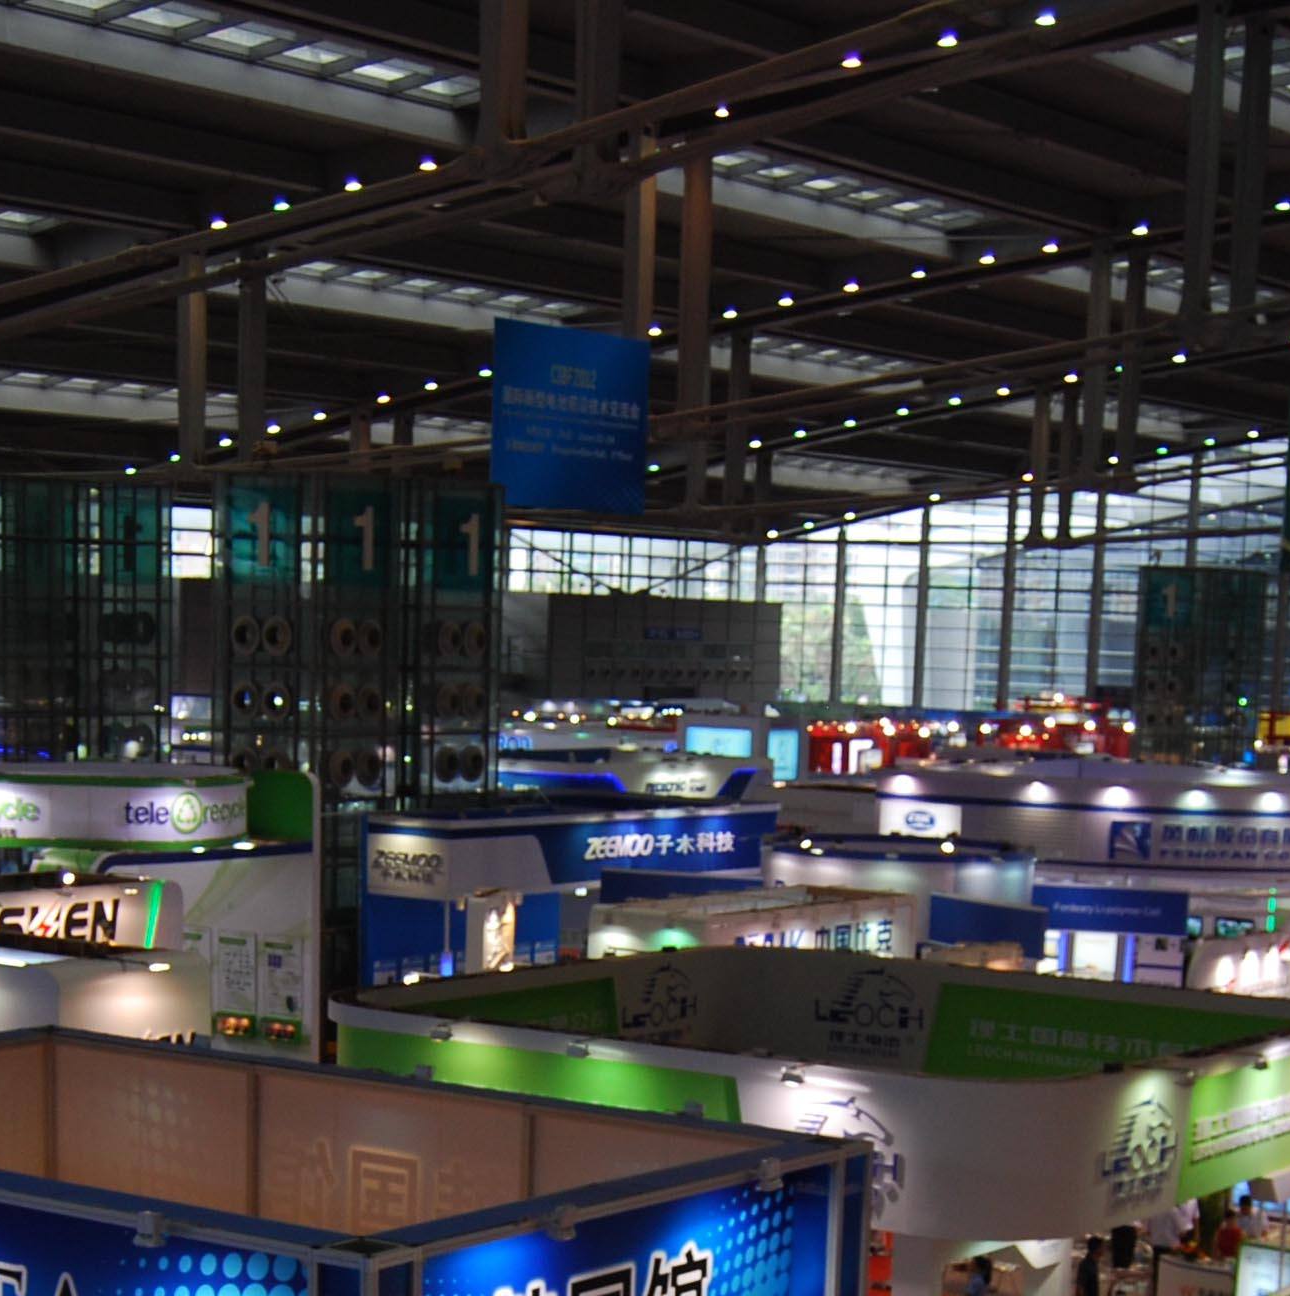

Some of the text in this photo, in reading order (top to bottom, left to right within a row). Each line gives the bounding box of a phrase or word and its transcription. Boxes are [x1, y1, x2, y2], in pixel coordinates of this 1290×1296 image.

[125, 801, 169, 824] tele
[655, 831, 736, 856] 子木科技
